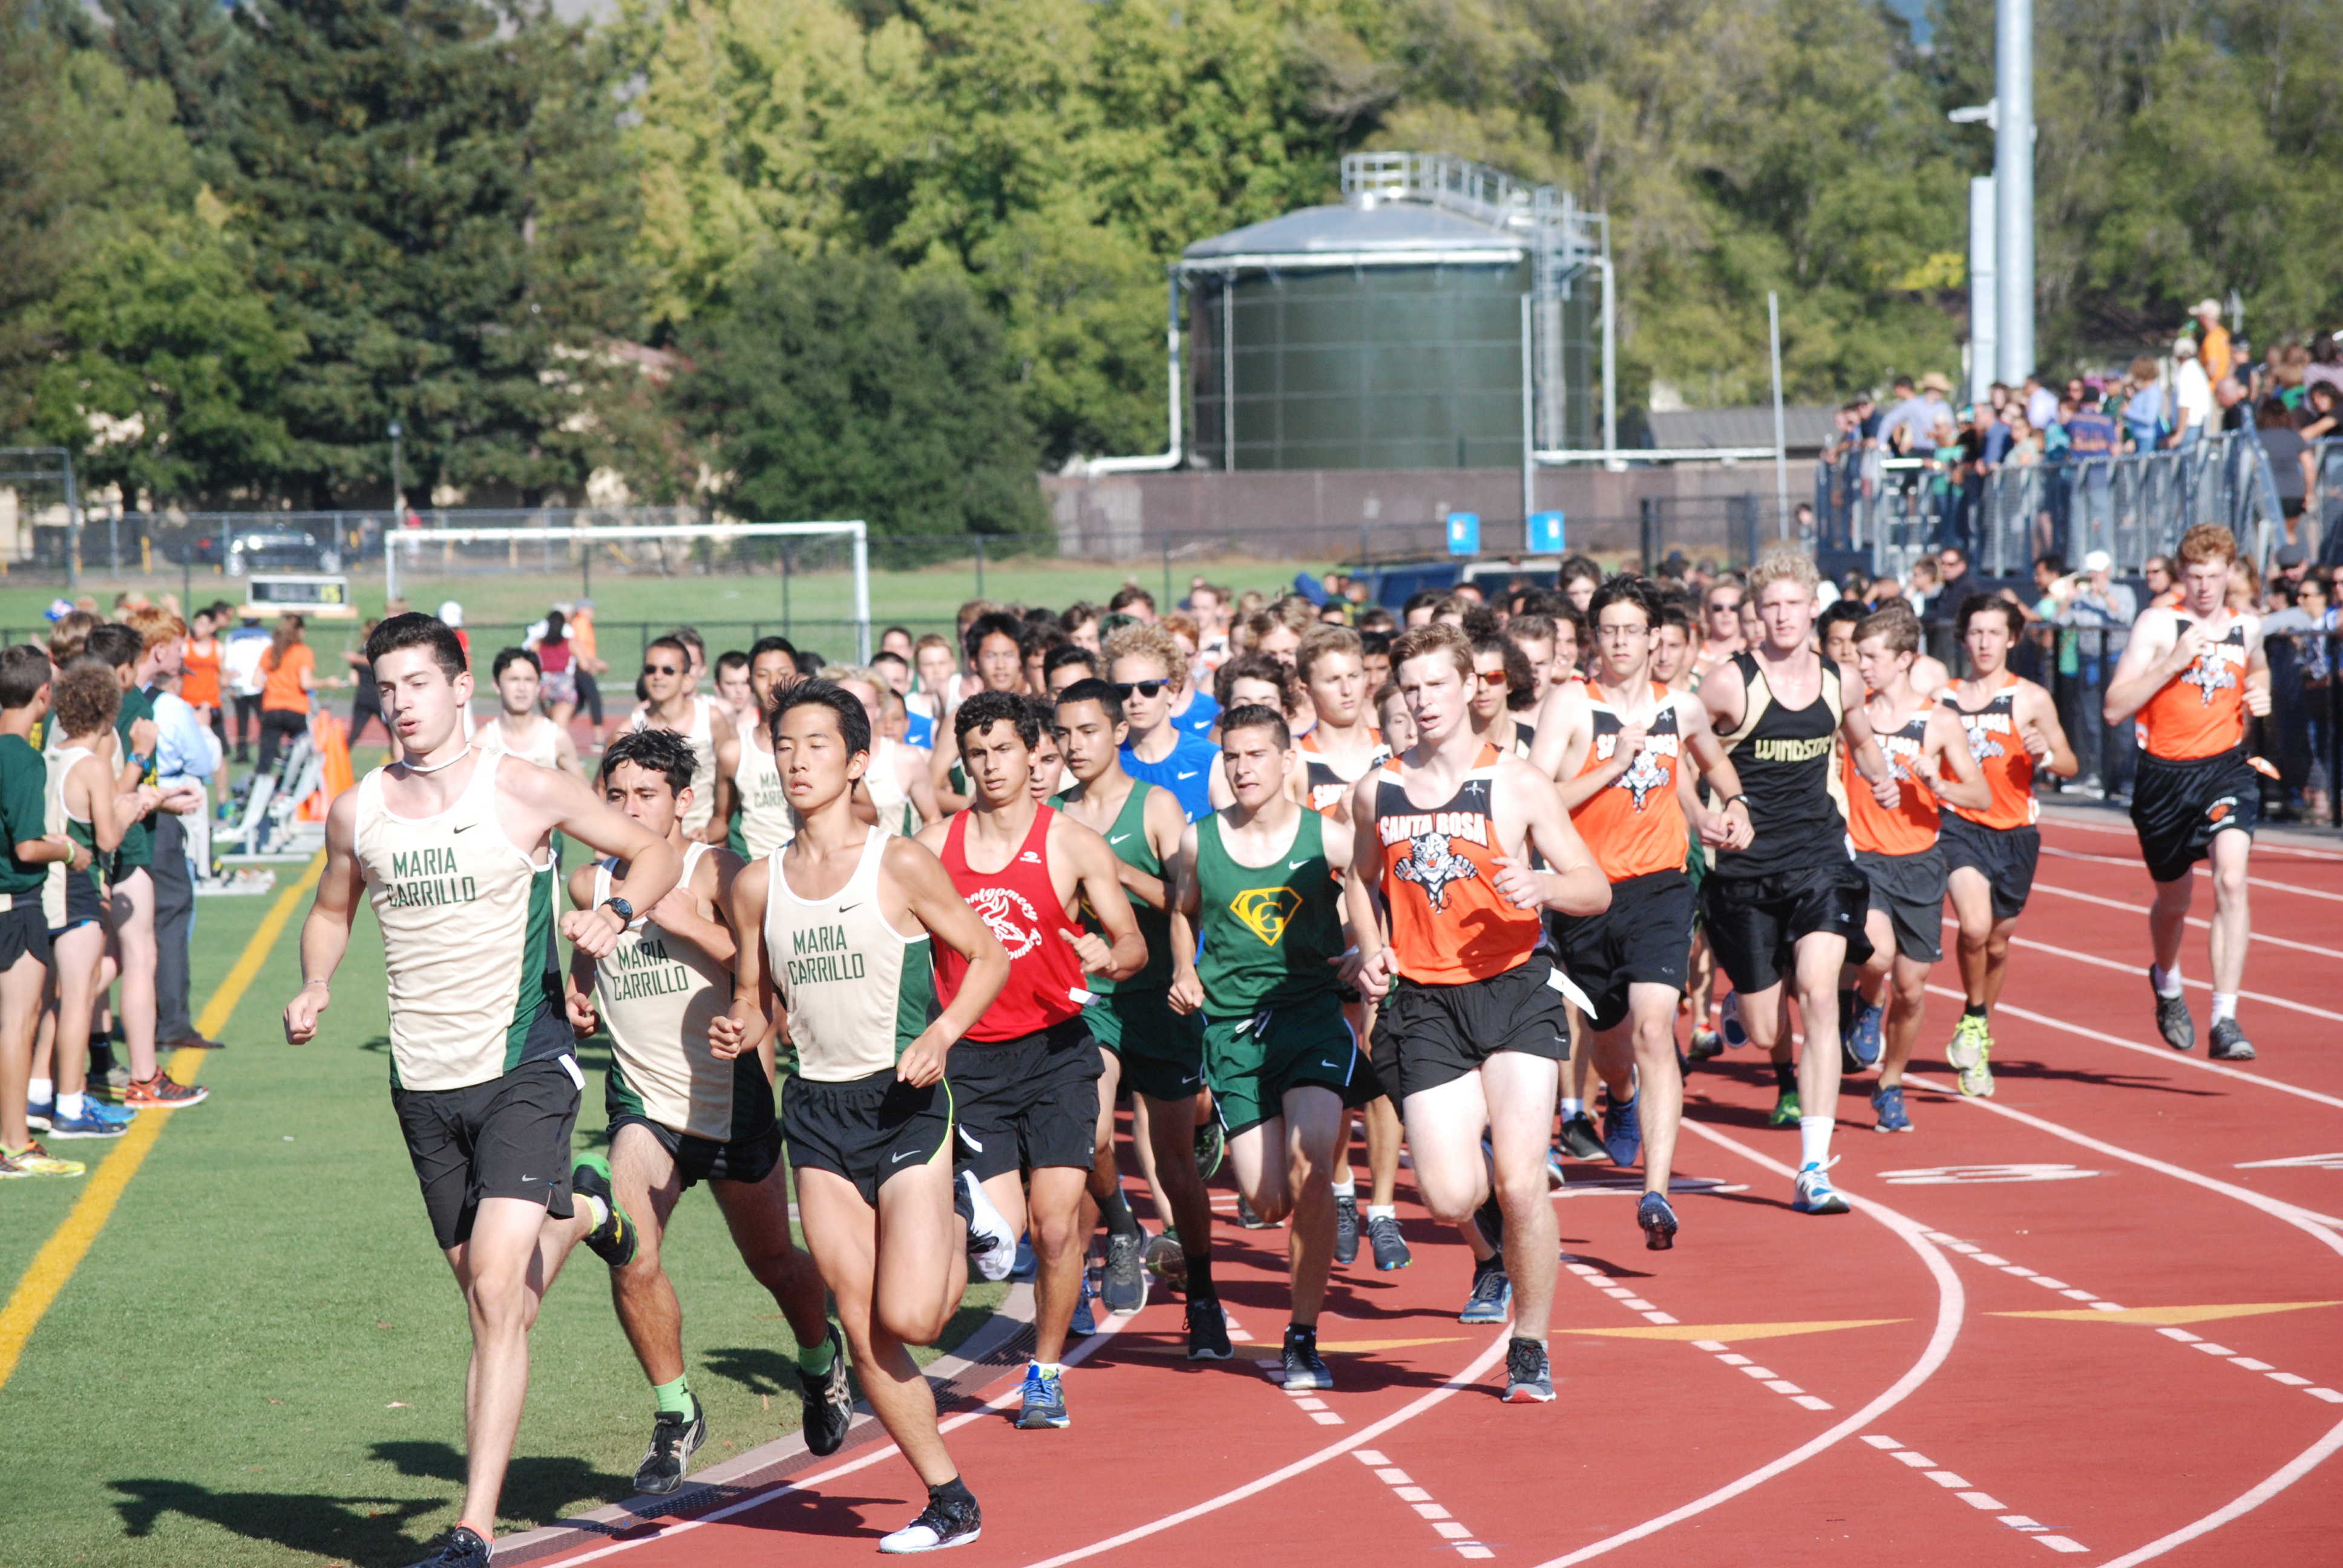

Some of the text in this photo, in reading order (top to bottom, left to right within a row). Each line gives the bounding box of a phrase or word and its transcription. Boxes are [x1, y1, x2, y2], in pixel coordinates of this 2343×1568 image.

[1977, 713, 2011, 735] ROSA
[1755, 735, 1830, 762] WINDSOR
[1380, 811, 1488, 848] SANTA ROSA
[393, 846, 457, 879] MARIA
[385, 876, 476, 907] CARRILLO
[616, 938, 670, 971] MARIA
[793, 924, 848, 956] MARIA
[612, 965, 689, 1001] CARRILLO
[787, 953, 865, 985] CARRILLO
